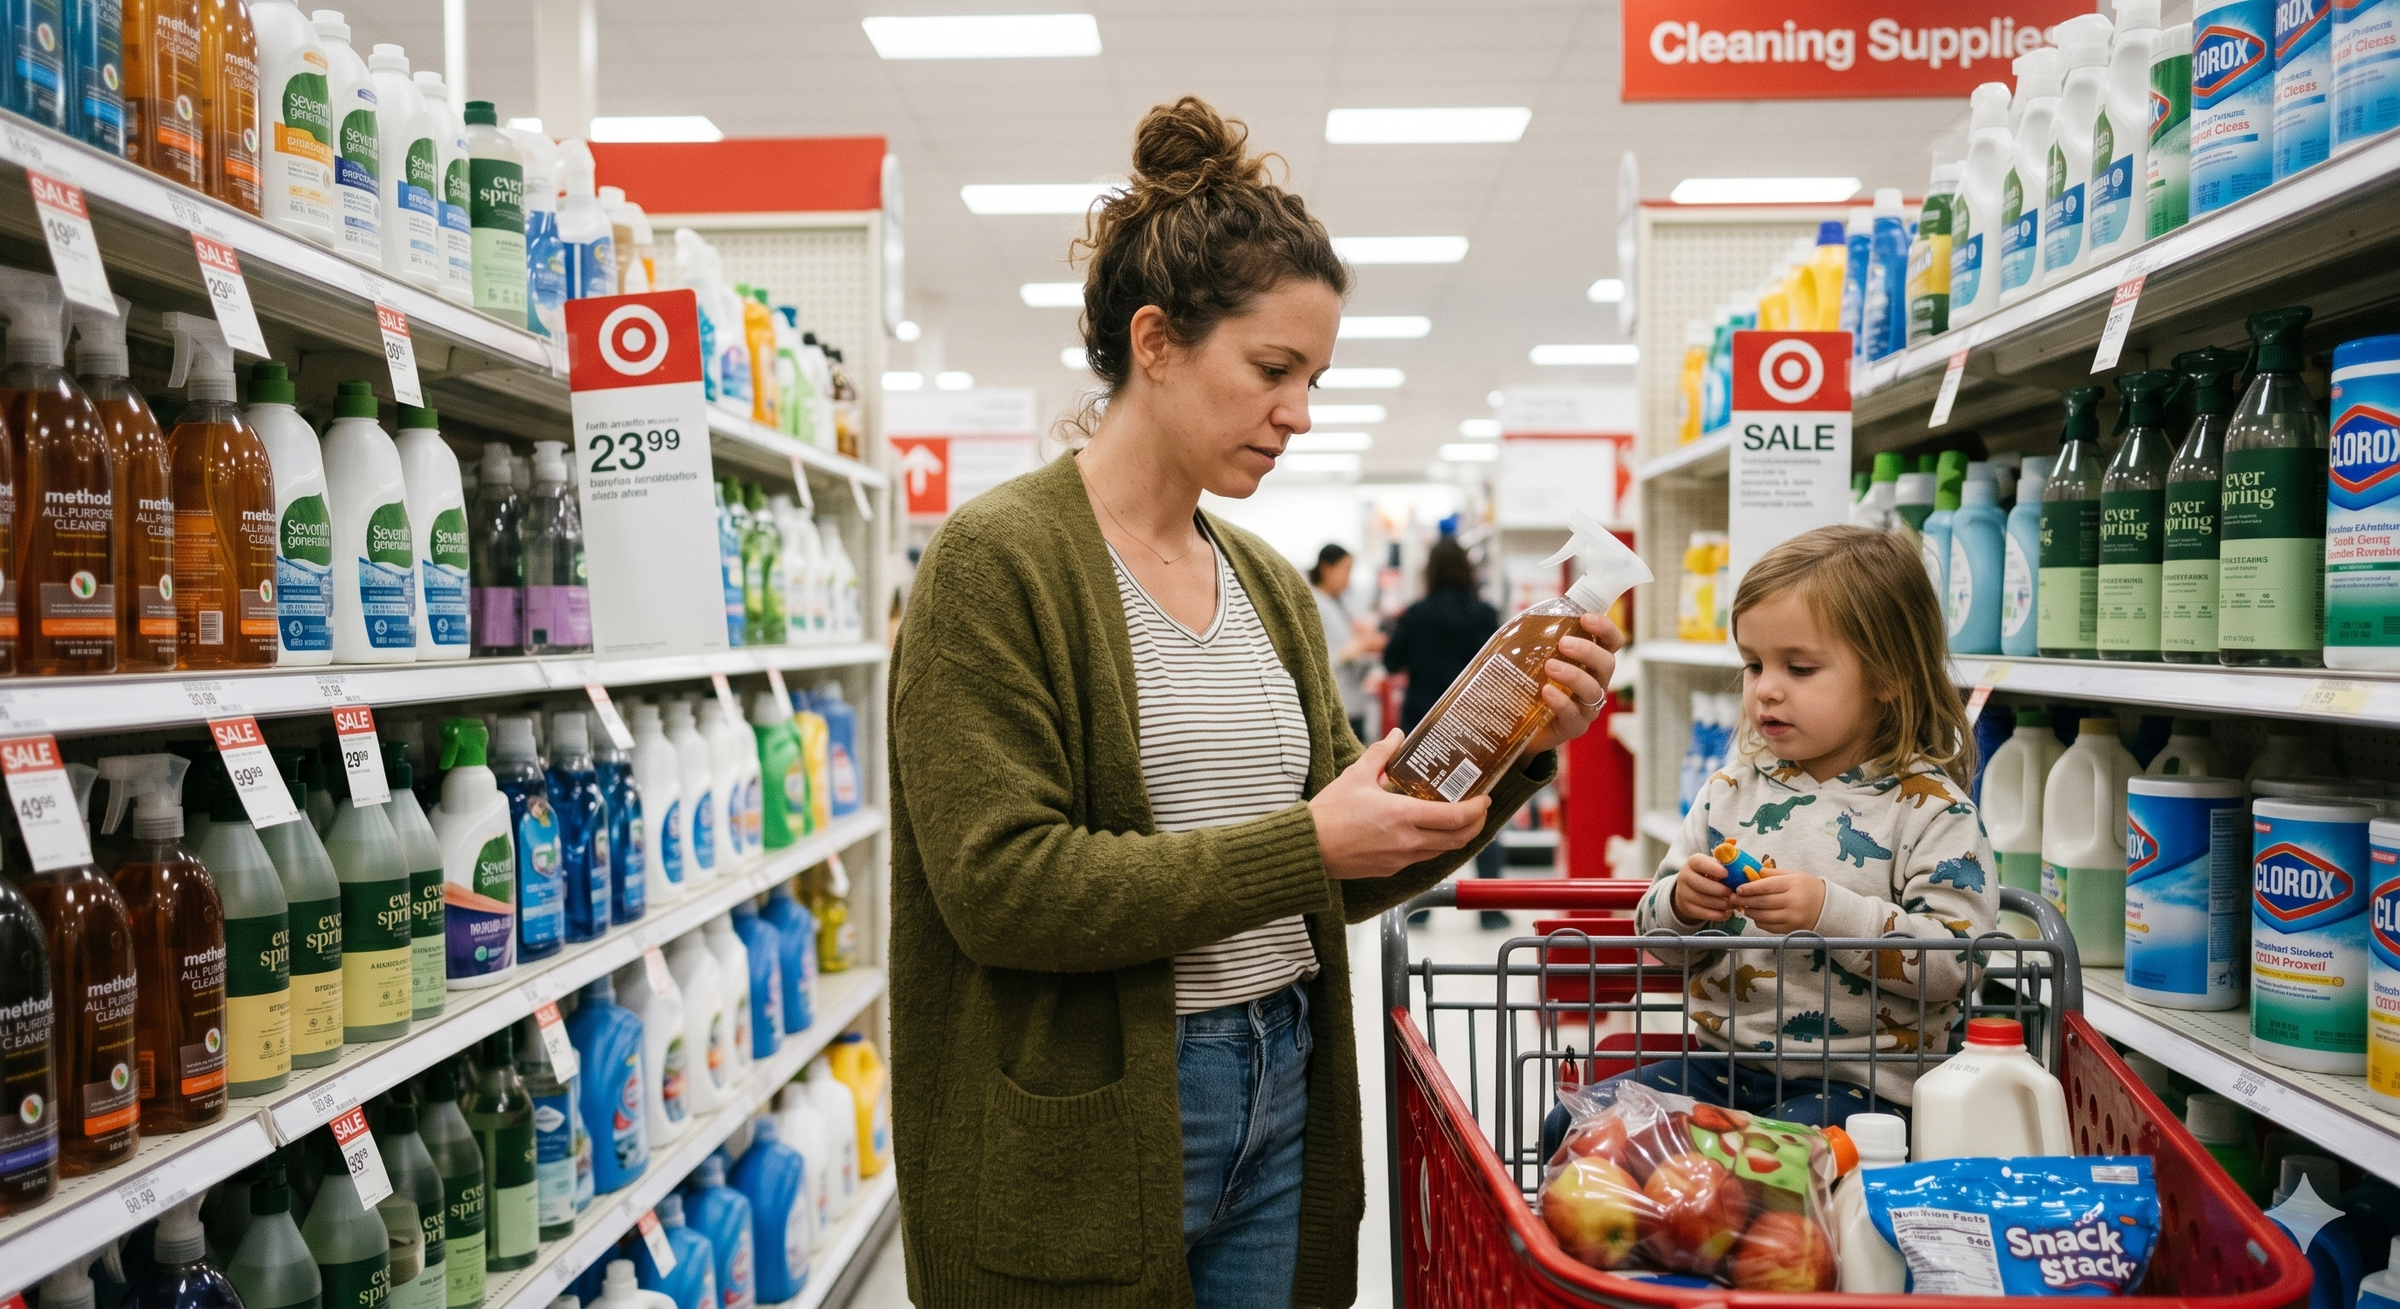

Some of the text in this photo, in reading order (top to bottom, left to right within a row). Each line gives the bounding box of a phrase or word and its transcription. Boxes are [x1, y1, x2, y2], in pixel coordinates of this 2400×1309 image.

[1648, 16, 2057, 72] Cleaning Supplie
[2193, 37, 2250, 82] LOROX
[31, 177, 83, 214] SALE
[480, 188, 526, 213] sprin
[196, 241, 237, 271] SALE
[2115, 281, 2142, 304] SALE
[379, 310, 407, 334] SALE
[1743, 424, 1835, 451] SALE
[2226, 471, 2266, 489] ever
[45, 488, 112, 506] method
[2168, 501, 2205, 515] ever
[54, 519, 107, 531] CLEANER
[2104, 508, 2140, 522] ever
[337, 711, 370, 731] SALE
[215, 723, 257, 746] SALE
[2, 742, 54, 770] SALE
[2255, 862, 2336, 900] CLOROX
[87, 971, 137, 998] method
[334, 1111, 365, 1141] SALE
[1952, 1212, 1986, 1224] Facts
[2006, 1221, 2124, 1257] Snack
[2040, 1254, 2136, 1286] Stack
